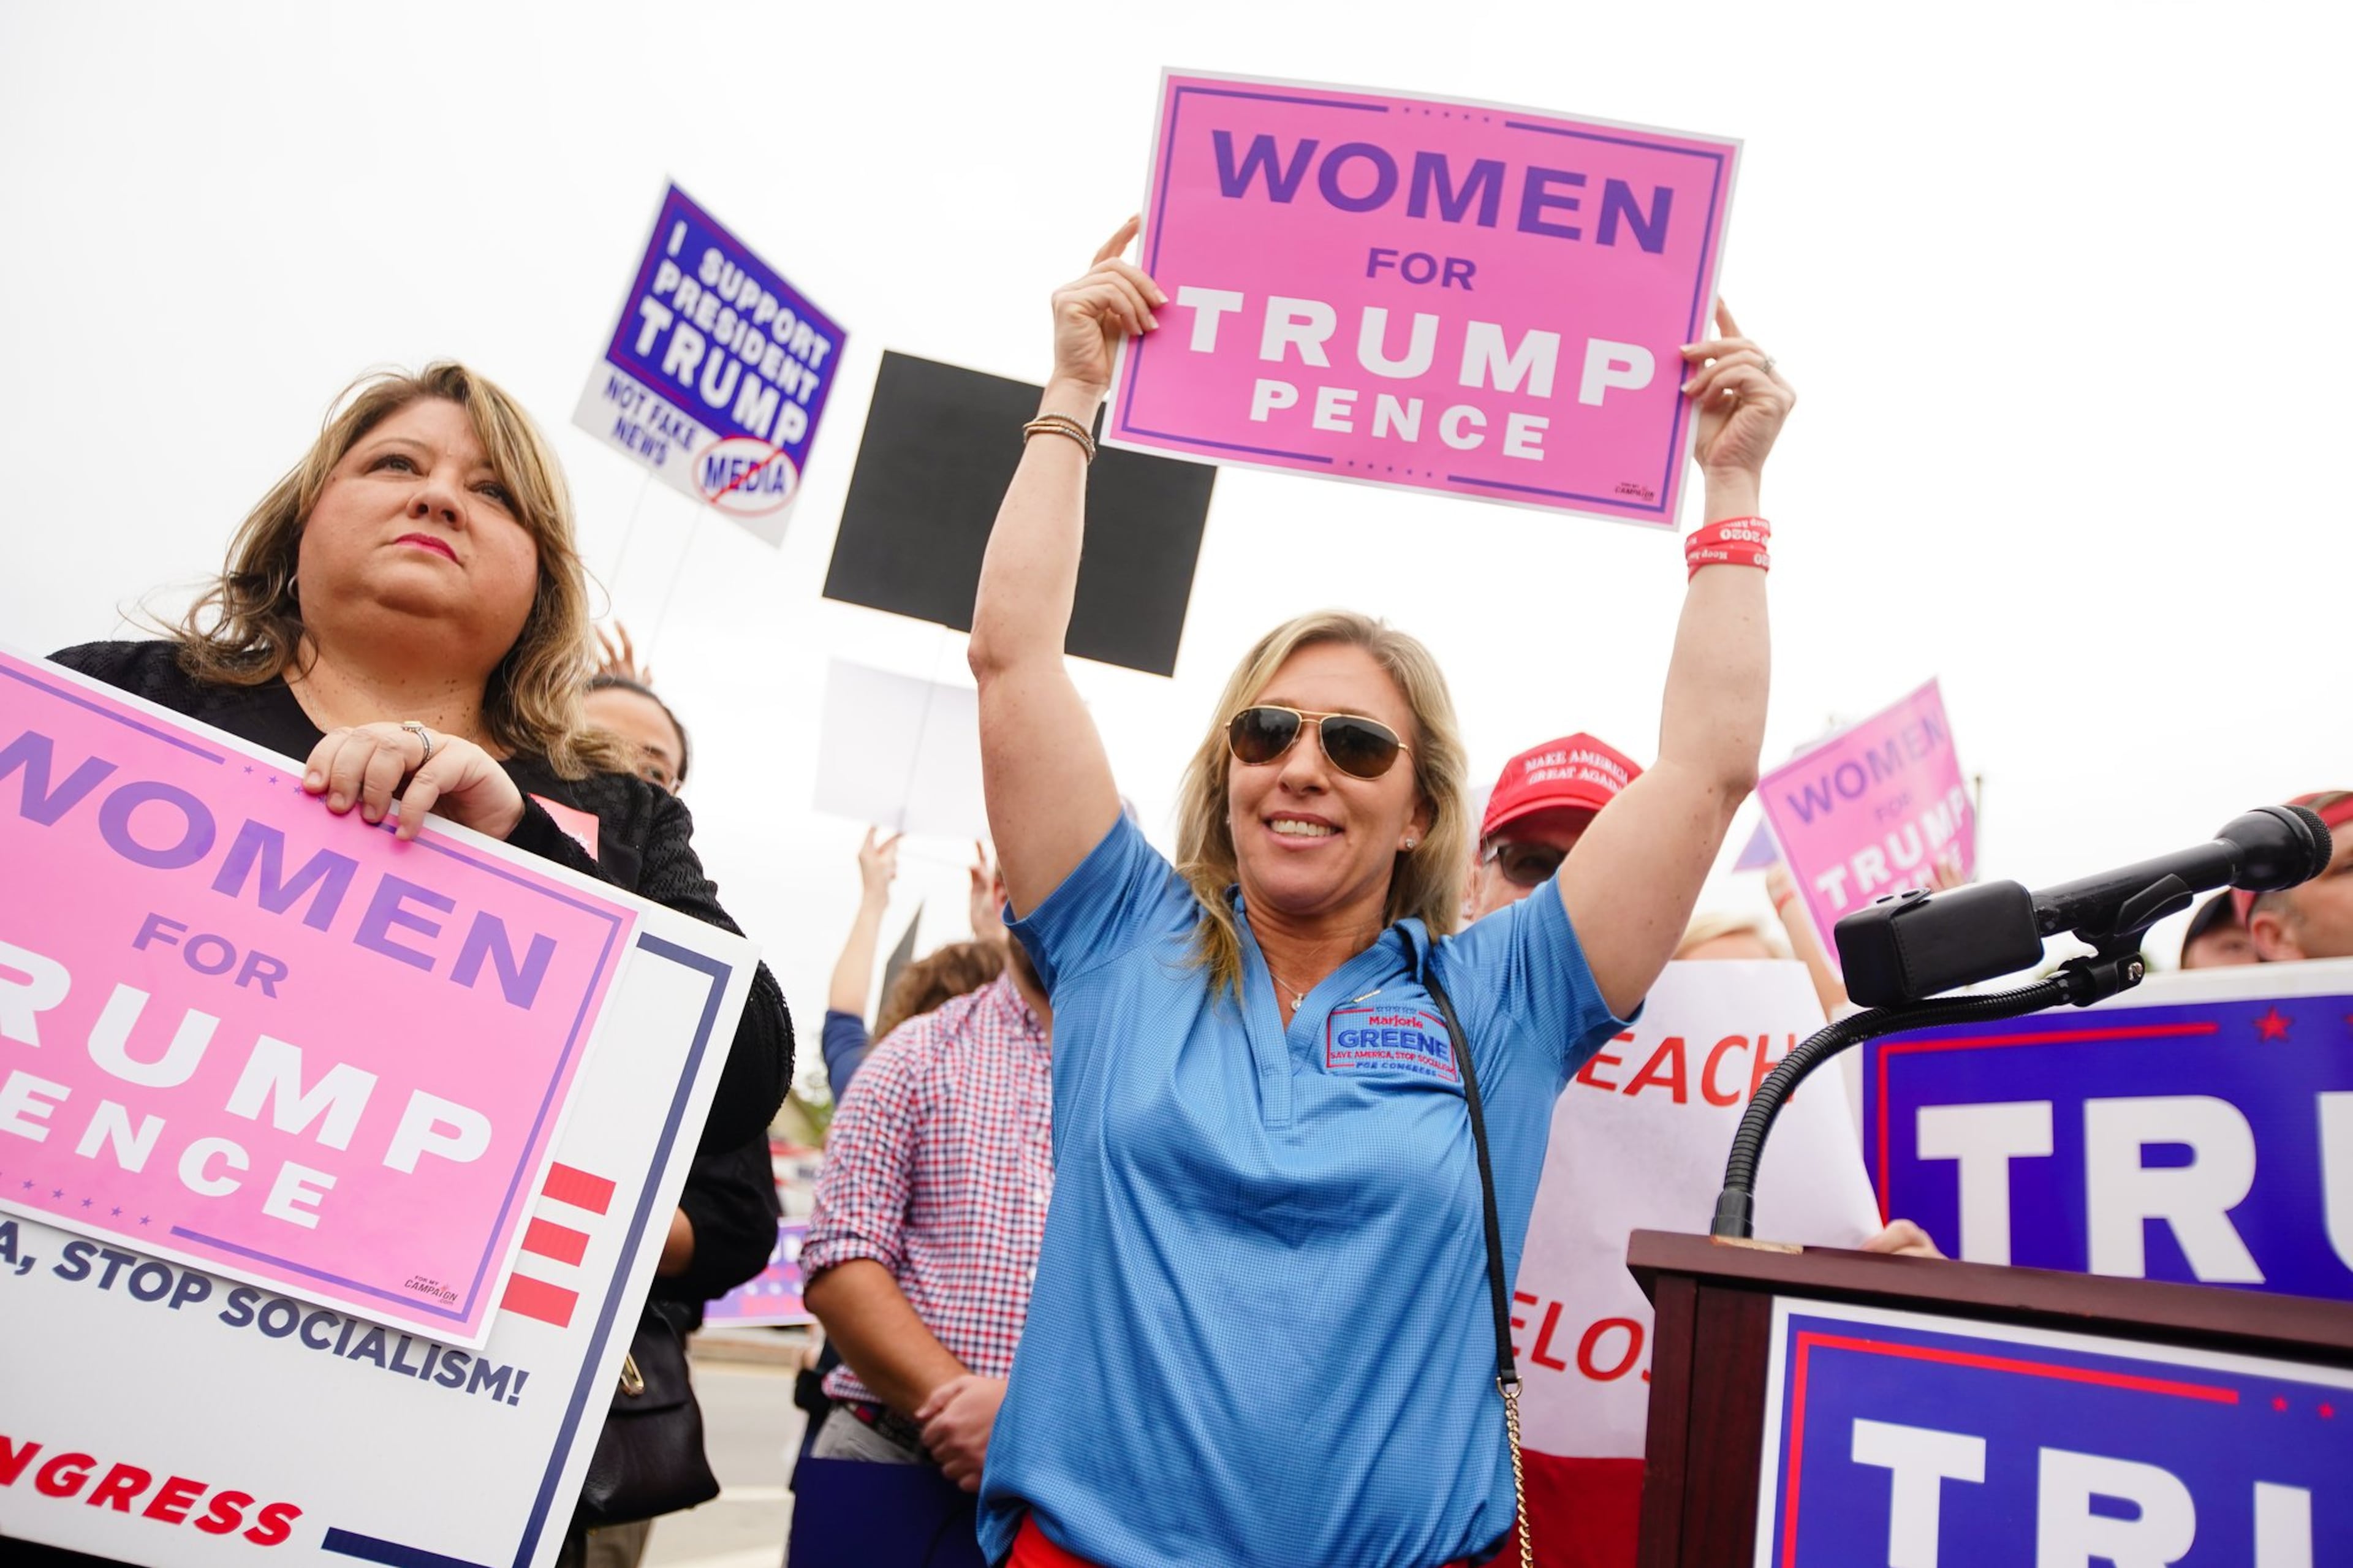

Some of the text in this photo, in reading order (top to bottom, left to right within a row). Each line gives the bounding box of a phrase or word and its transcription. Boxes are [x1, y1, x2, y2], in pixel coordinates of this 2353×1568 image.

[1211, 130, 1673, 256] WOMEN
[666, 220, 831, 369] I SUPPORT
[1366, 247, 1477, 290] FOR
[634, 295, 809, 448] TRUMP
[652, 259, 820, 405] PRESIDENT
[1175, 285, 1656, 407] TRUMP
[602, 372, 696, 452] NOT FAKE
[611, 415, 670, 469] NEWS
[1248, 378, 1550, 461] PENCE
[703, 454, 786, 496] MEDIA
[1525, 749, 1628, 785] MAKE AMERICA
[1528, 765, 1577, 785] GREAT
[1786, 714, 1946, 827] WOMEN
[1814, 784, 1966, 912] TRUMP
[131, 912, 289, 999] FOR
[1330, 1050, 1352, 1059] SAVE
[1394, 1051, 1416, 1061] STOP
[1338, 1028, 1448, 1059] GREENE
[1368, 1014, 1423, 1029] Marjorie
[0, 1069, 338, 1230] ENCE
[52, 1240, 211, 1311] STOP
[219, 1287, 530, 1407] SOCIALISM!
[404, 1279, 458, 1301] CAMPAIGN
[1510, 1290, 1651, 1385] LO
